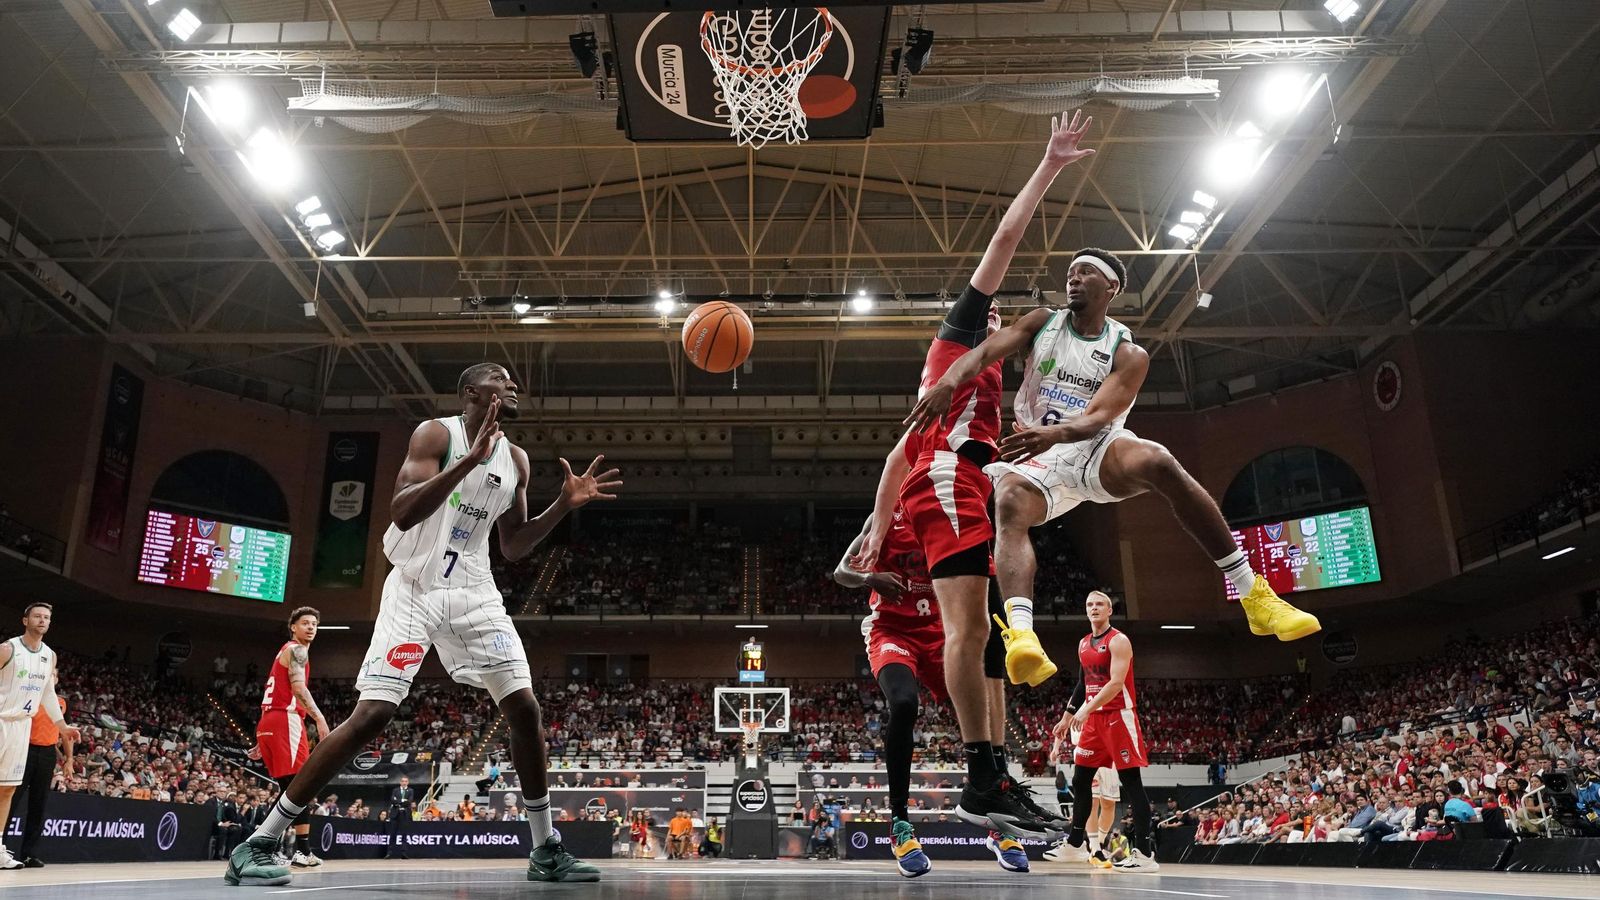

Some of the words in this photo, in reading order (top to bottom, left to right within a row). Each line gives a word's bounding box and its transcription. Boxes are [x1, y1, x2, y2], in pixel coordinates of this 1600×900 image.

[661, 48, 680, 88] Murcia
[1057, 369, 1102, 391] Unicaja
[1039, 384, 1087, 408] málaga
[458, 502, 488, 521] nicaja
[195, 543, 209, 555] 25
[1270, 547, 1284, 559] 25
[1305, 541, 1320, 553] 22
[229, 549, 242, 560] 22
[205, 558, 229, 569] 7:02
[443, 550, 459, 578] 7
[1284, 556, 1309, 568] 7:02
[1295, 571, 1301, 579] 2
[916, 598, 931, 616] 8
[747, 659, 762, 670] 14
[23, 699, 32, 713] 4
[41, 819, 77, 837] SKET
[78, 820, 87, 837] Y
[87, 821, 102, 838] LA
[104, 817, 145, 838] MÚSICA
[444, 834, 453, 845] Y
[454, 834, 471, 845] LA
[473, 832, 519, 845] MÚSICA
[875, 837, 891, 845] END
[920, 835, 952, 845] ENERGÍA
[953, 837, 969, 845] DEL
[969, 837, 988, 845] BASK
